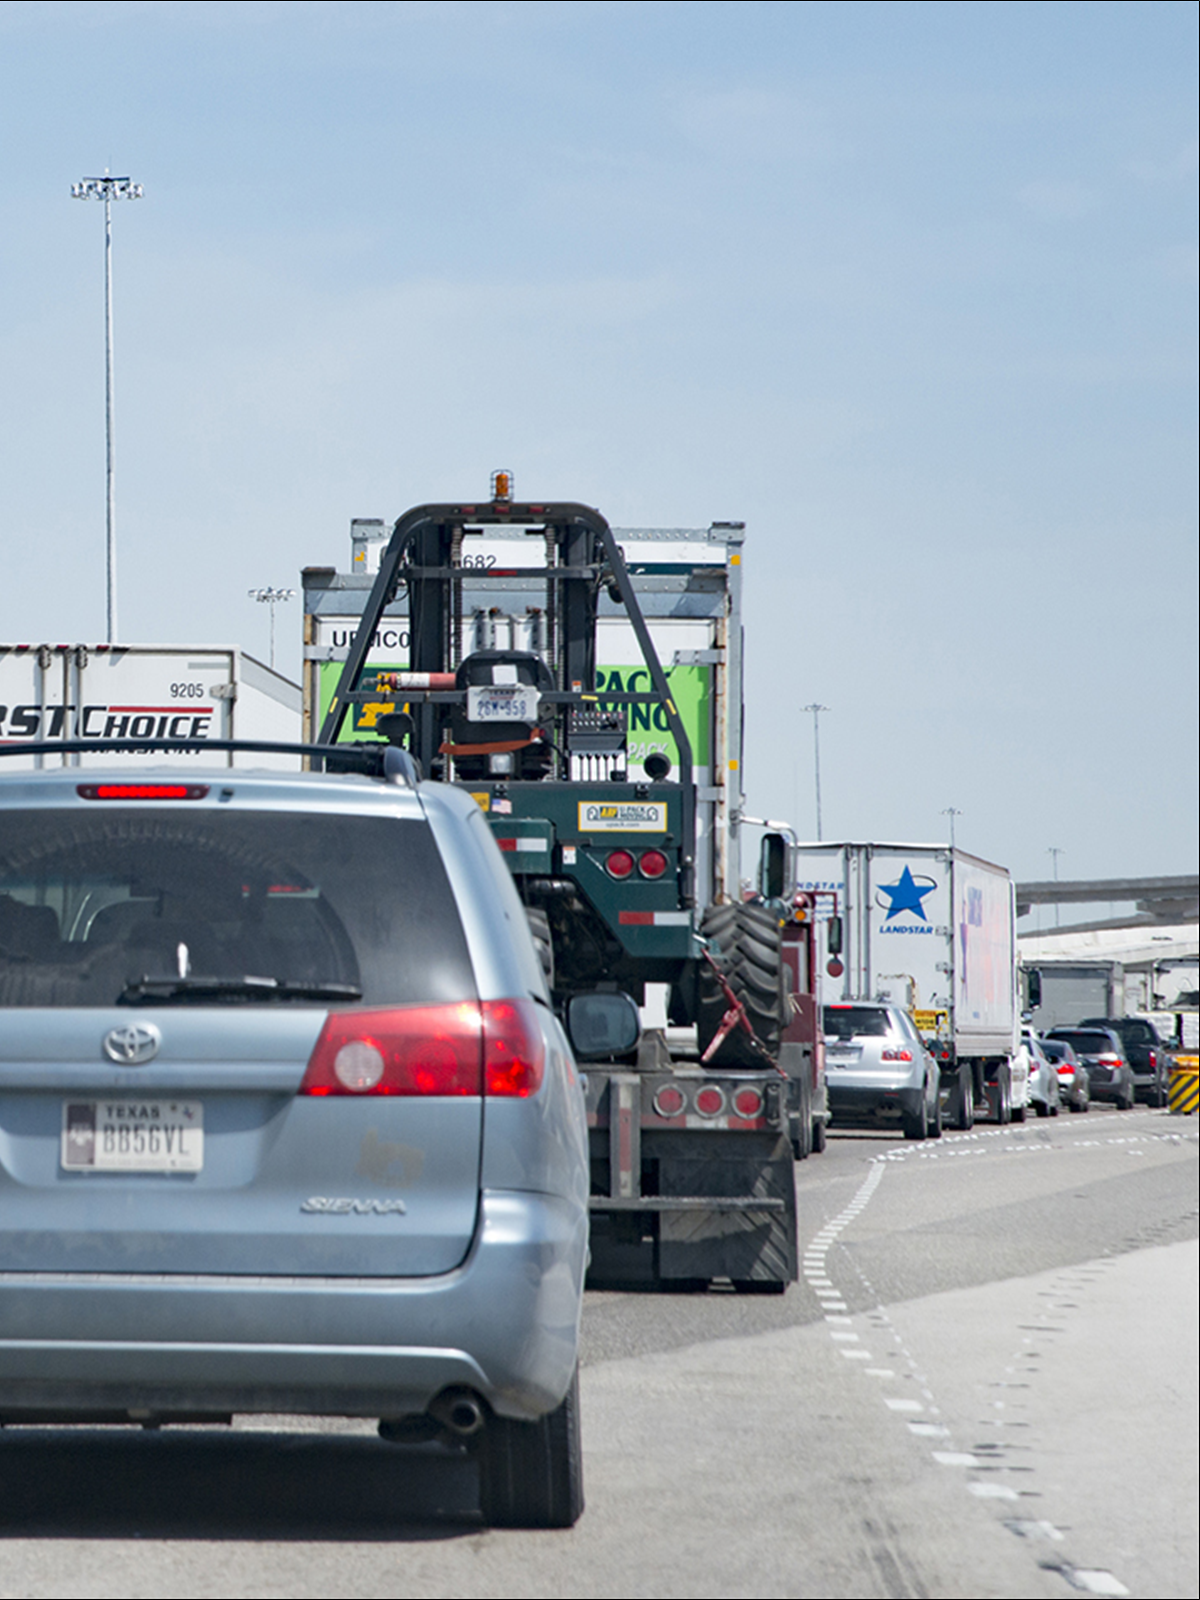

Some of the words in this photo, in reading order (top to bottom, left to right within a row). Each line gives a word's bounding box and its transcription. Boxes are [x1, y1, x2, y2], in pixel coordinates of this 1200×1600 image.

[169, 683, 205, 699] 9205
[879, 925, 934, 935] LANDSTAR
[105, 1103, 161, 1120] TEXAS
[300, 1196, 407, 1216] SIENNA
